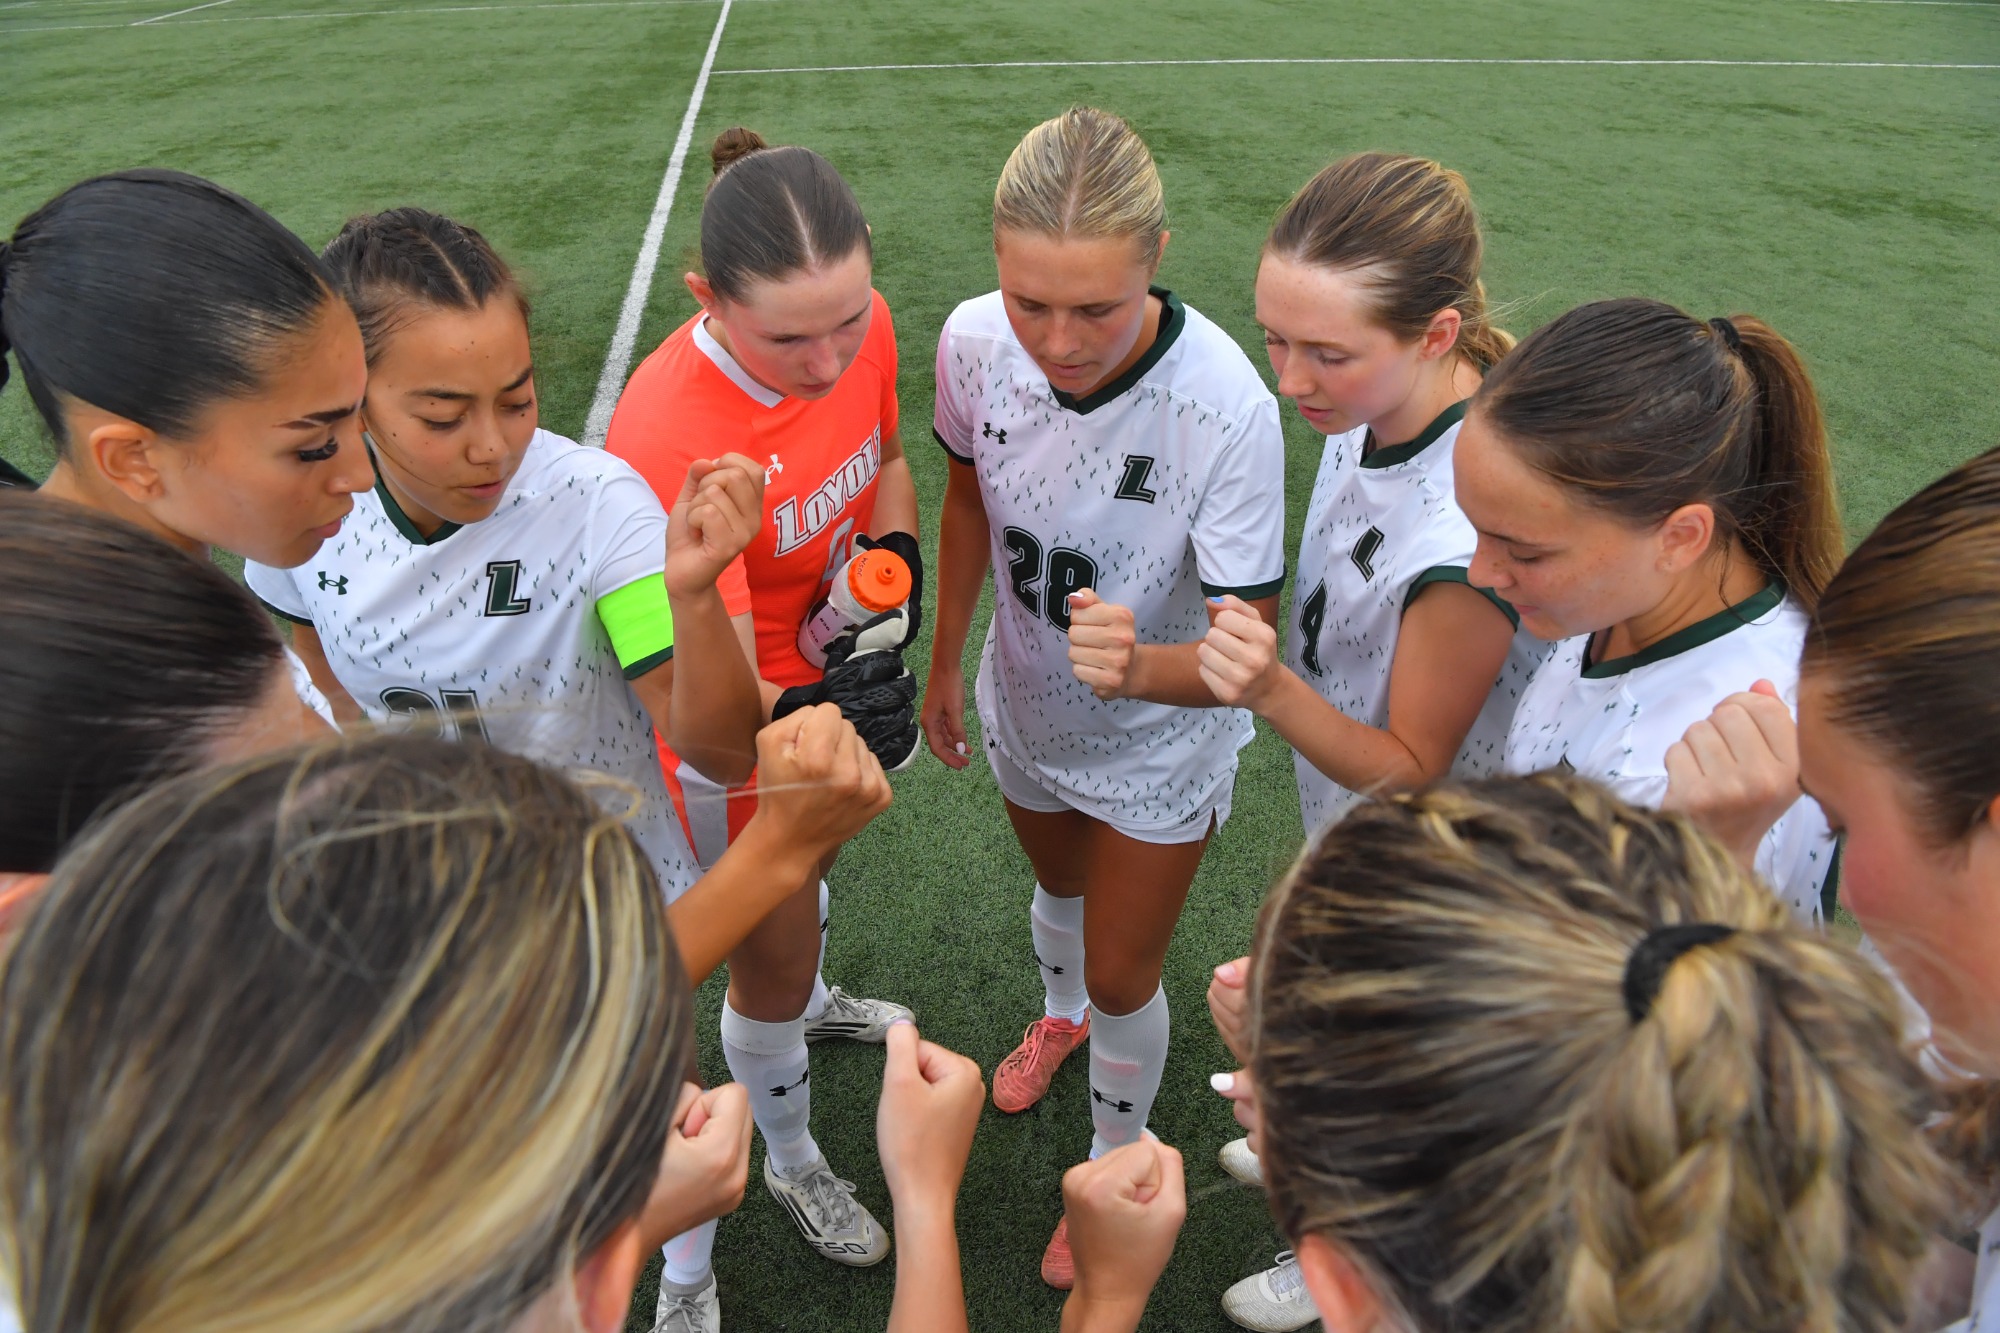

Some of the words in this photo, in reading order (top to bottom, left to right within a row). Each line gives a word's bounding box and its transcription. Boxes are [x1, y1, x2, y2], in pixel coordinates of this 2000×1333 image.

[1114, 454, 1156, 504] L
[484, 559, 531, 617] L
[1003, 526, 1098, 634] 28
